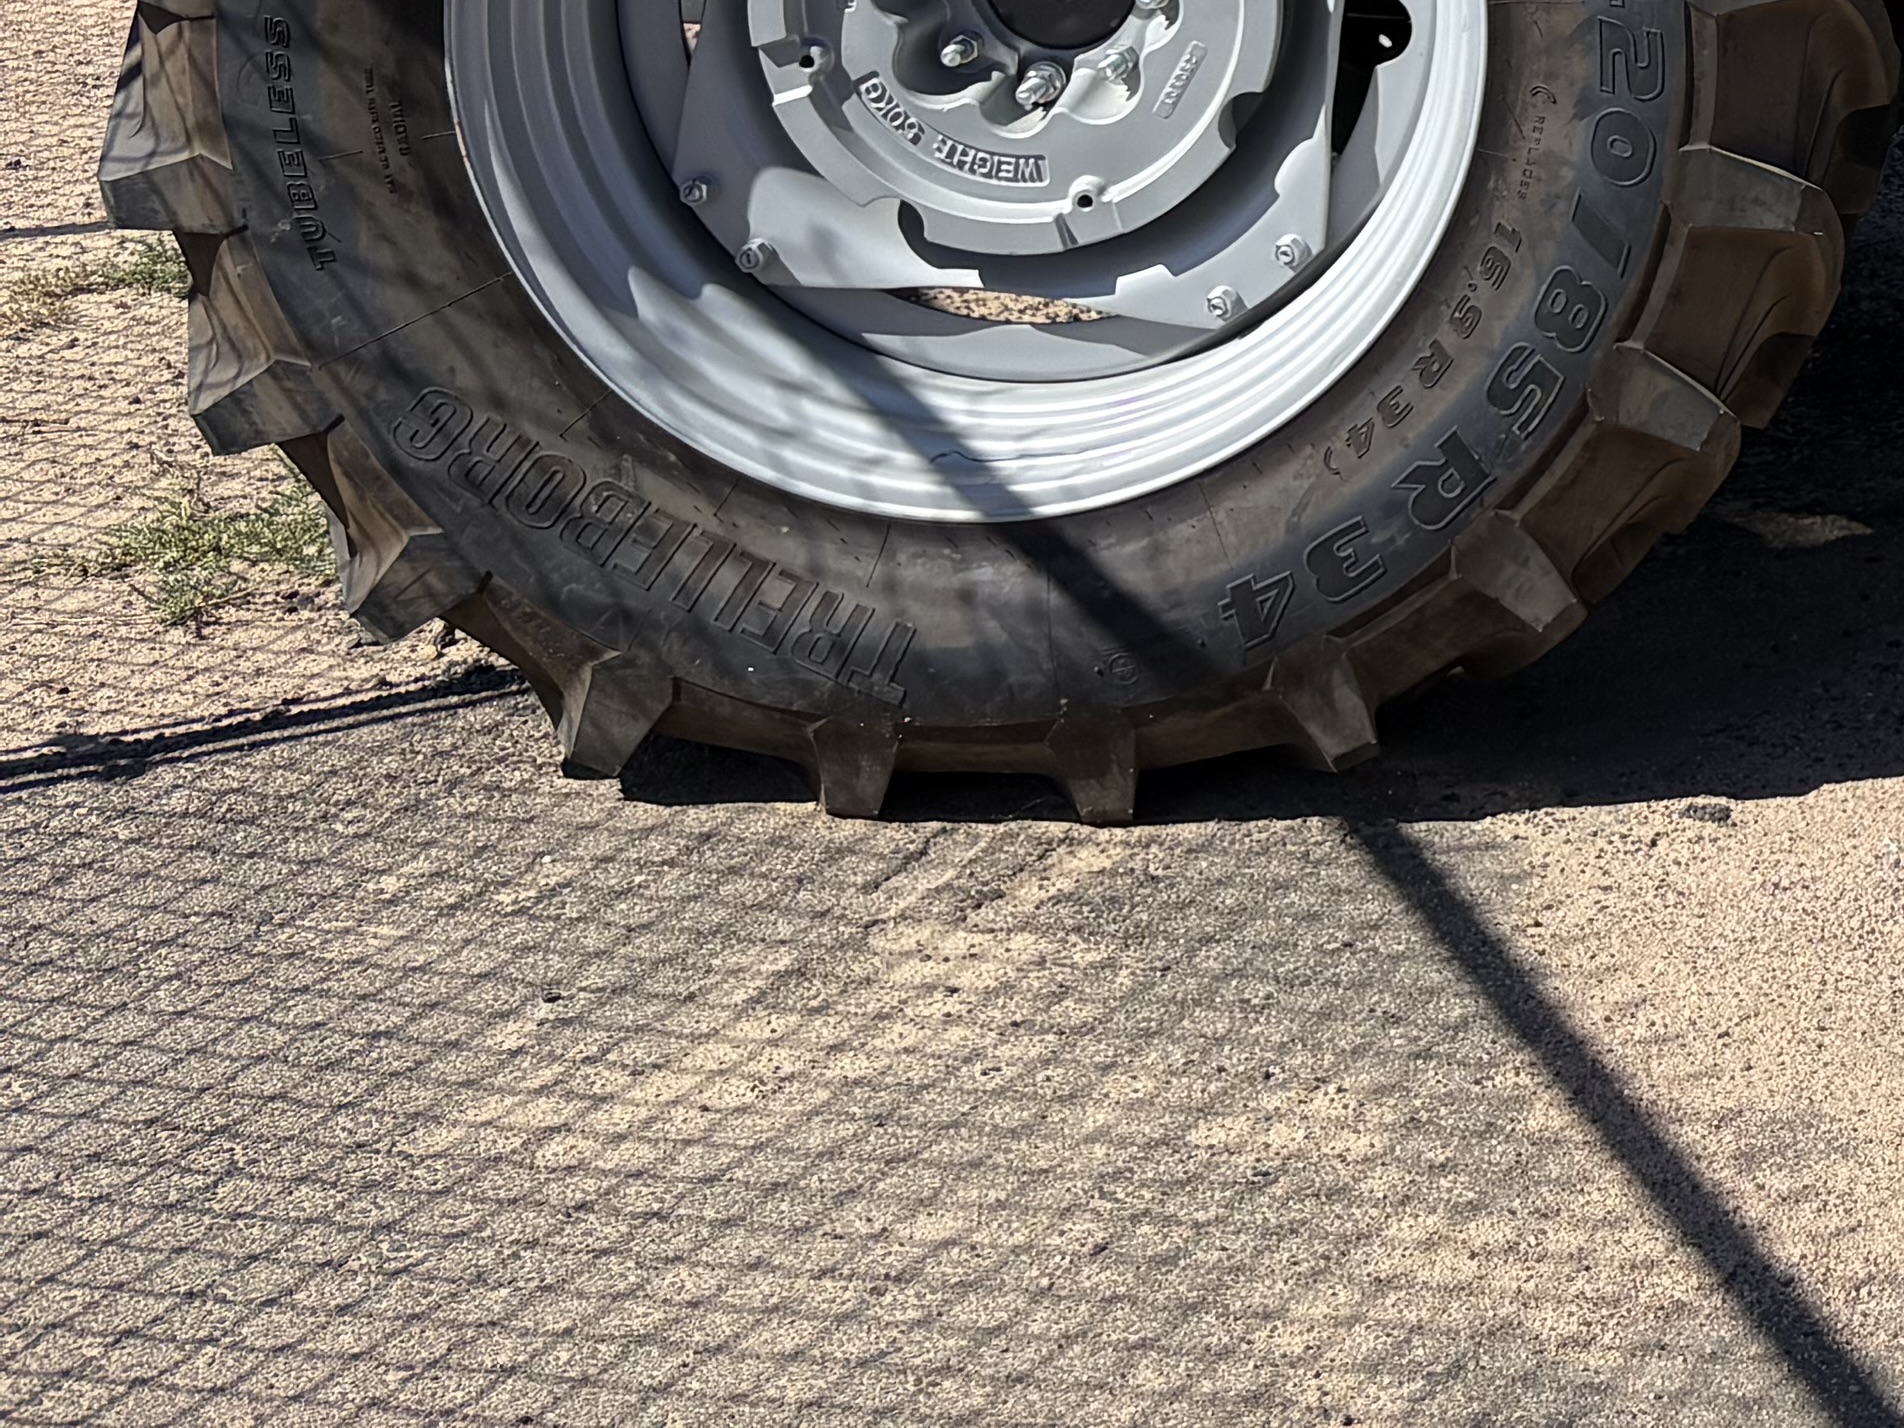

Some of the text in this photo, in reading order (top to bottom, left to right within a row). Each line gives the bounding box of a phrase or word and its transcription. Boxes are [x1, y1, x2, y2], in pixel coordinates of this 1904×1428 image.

[264, 14, 338, 271] TUBELESS
[390, 387, 918, 708] TRELLEBORG
[1393, 424, 1499, 531] R
[1219, 517, 1387, 656] 34
